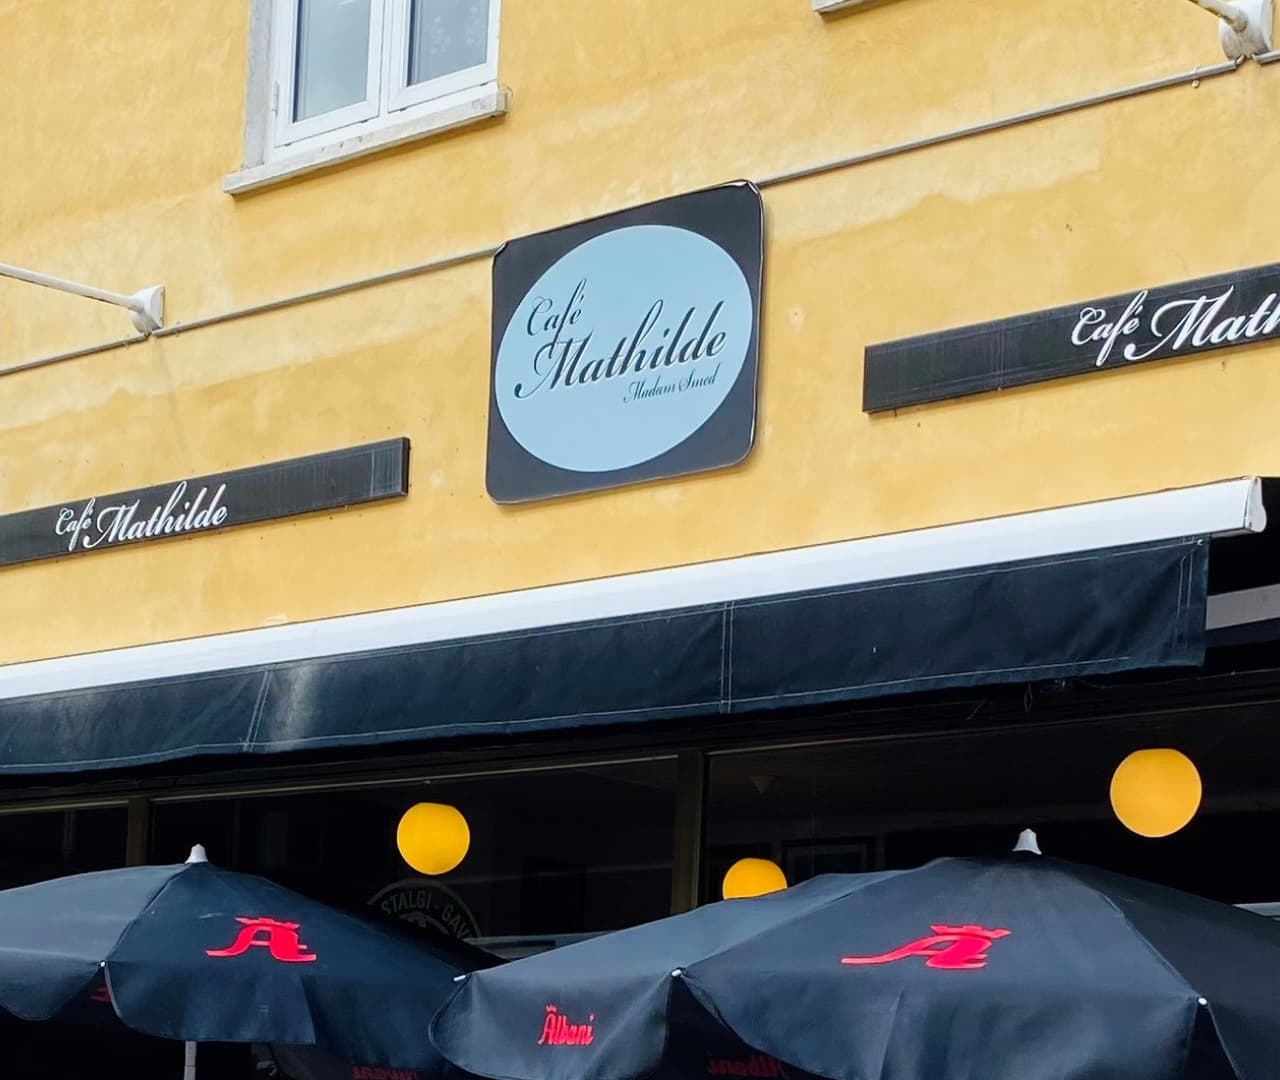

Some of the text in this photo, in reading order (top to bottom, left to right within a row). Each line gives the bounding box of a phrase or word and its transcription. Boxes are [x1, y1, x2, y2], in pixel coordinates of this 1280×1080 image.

[514, 299, 726, 398] Mathilde
[527, 278, 587, 349] Café
[1072, 290, 1148, 367] Café
[623, 364, 720, 403] Madam Smed
[56, 481, 228, 552] Café Mathilde
[538, 1004, 594, 1046] Albani
